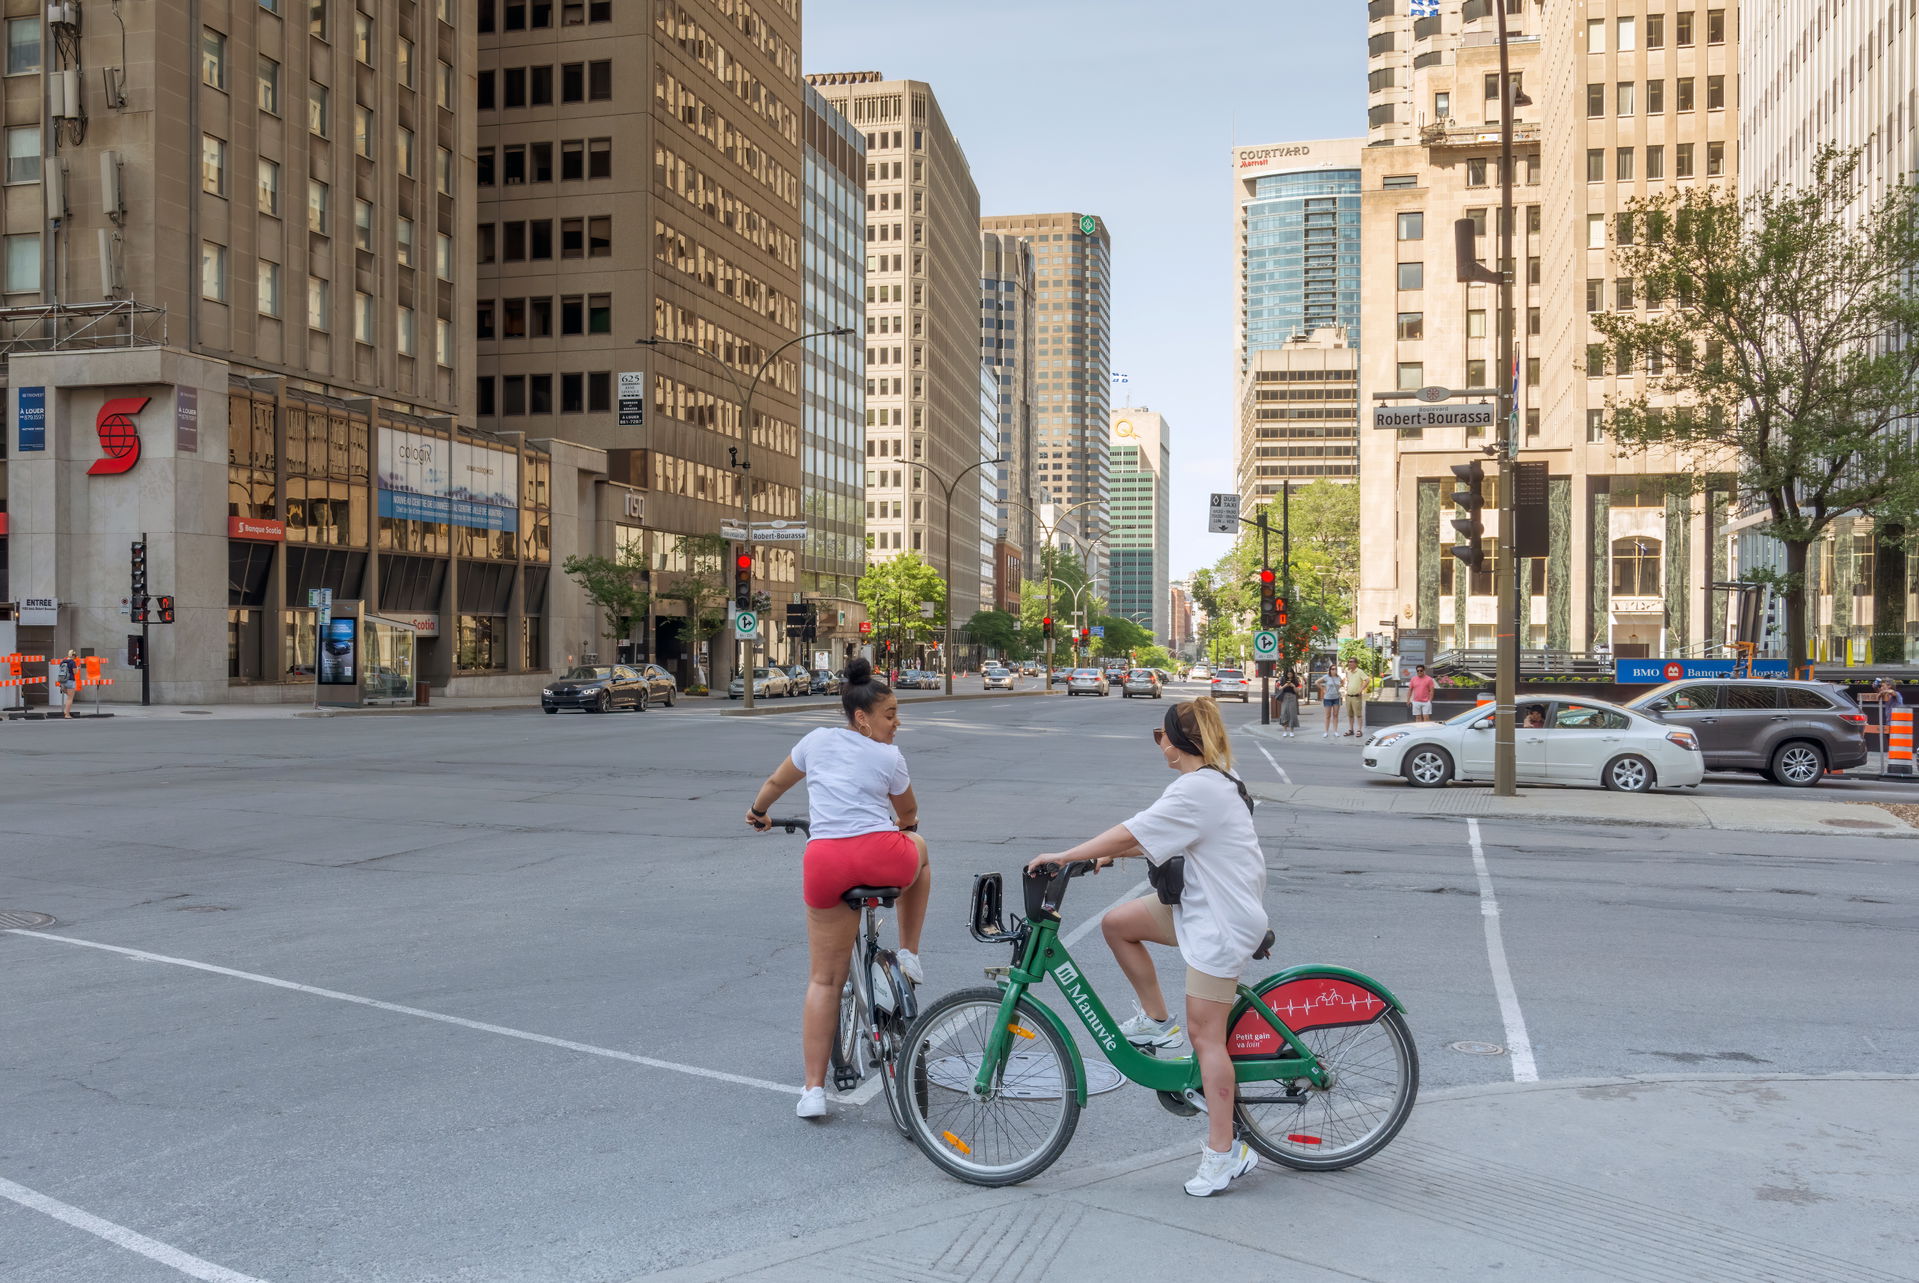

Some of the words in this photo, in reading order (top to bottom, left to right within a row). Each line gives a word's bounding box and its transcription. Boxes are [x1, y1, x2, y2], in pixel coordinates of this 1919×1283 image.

[1240, 146, 1310, 161] COURTYARD
[1376, 411, 1491, 426] Robert-Bourassa
[399, 444, 432, 465] cologix
[244, 524, 264, 534] Banque
[265, 526, 281, 534] Scotia
[753, 532, 806, 540] Robert-Bourassa
[413, 618, 435, 630] Scotia
[1632, 668, 1660, 677] BMO
[1688, 668, 1727, 680] Banqu
[1066, 982, 1117, 1051] Manuvie
[1254, 1032, 1270, 1041] gain
